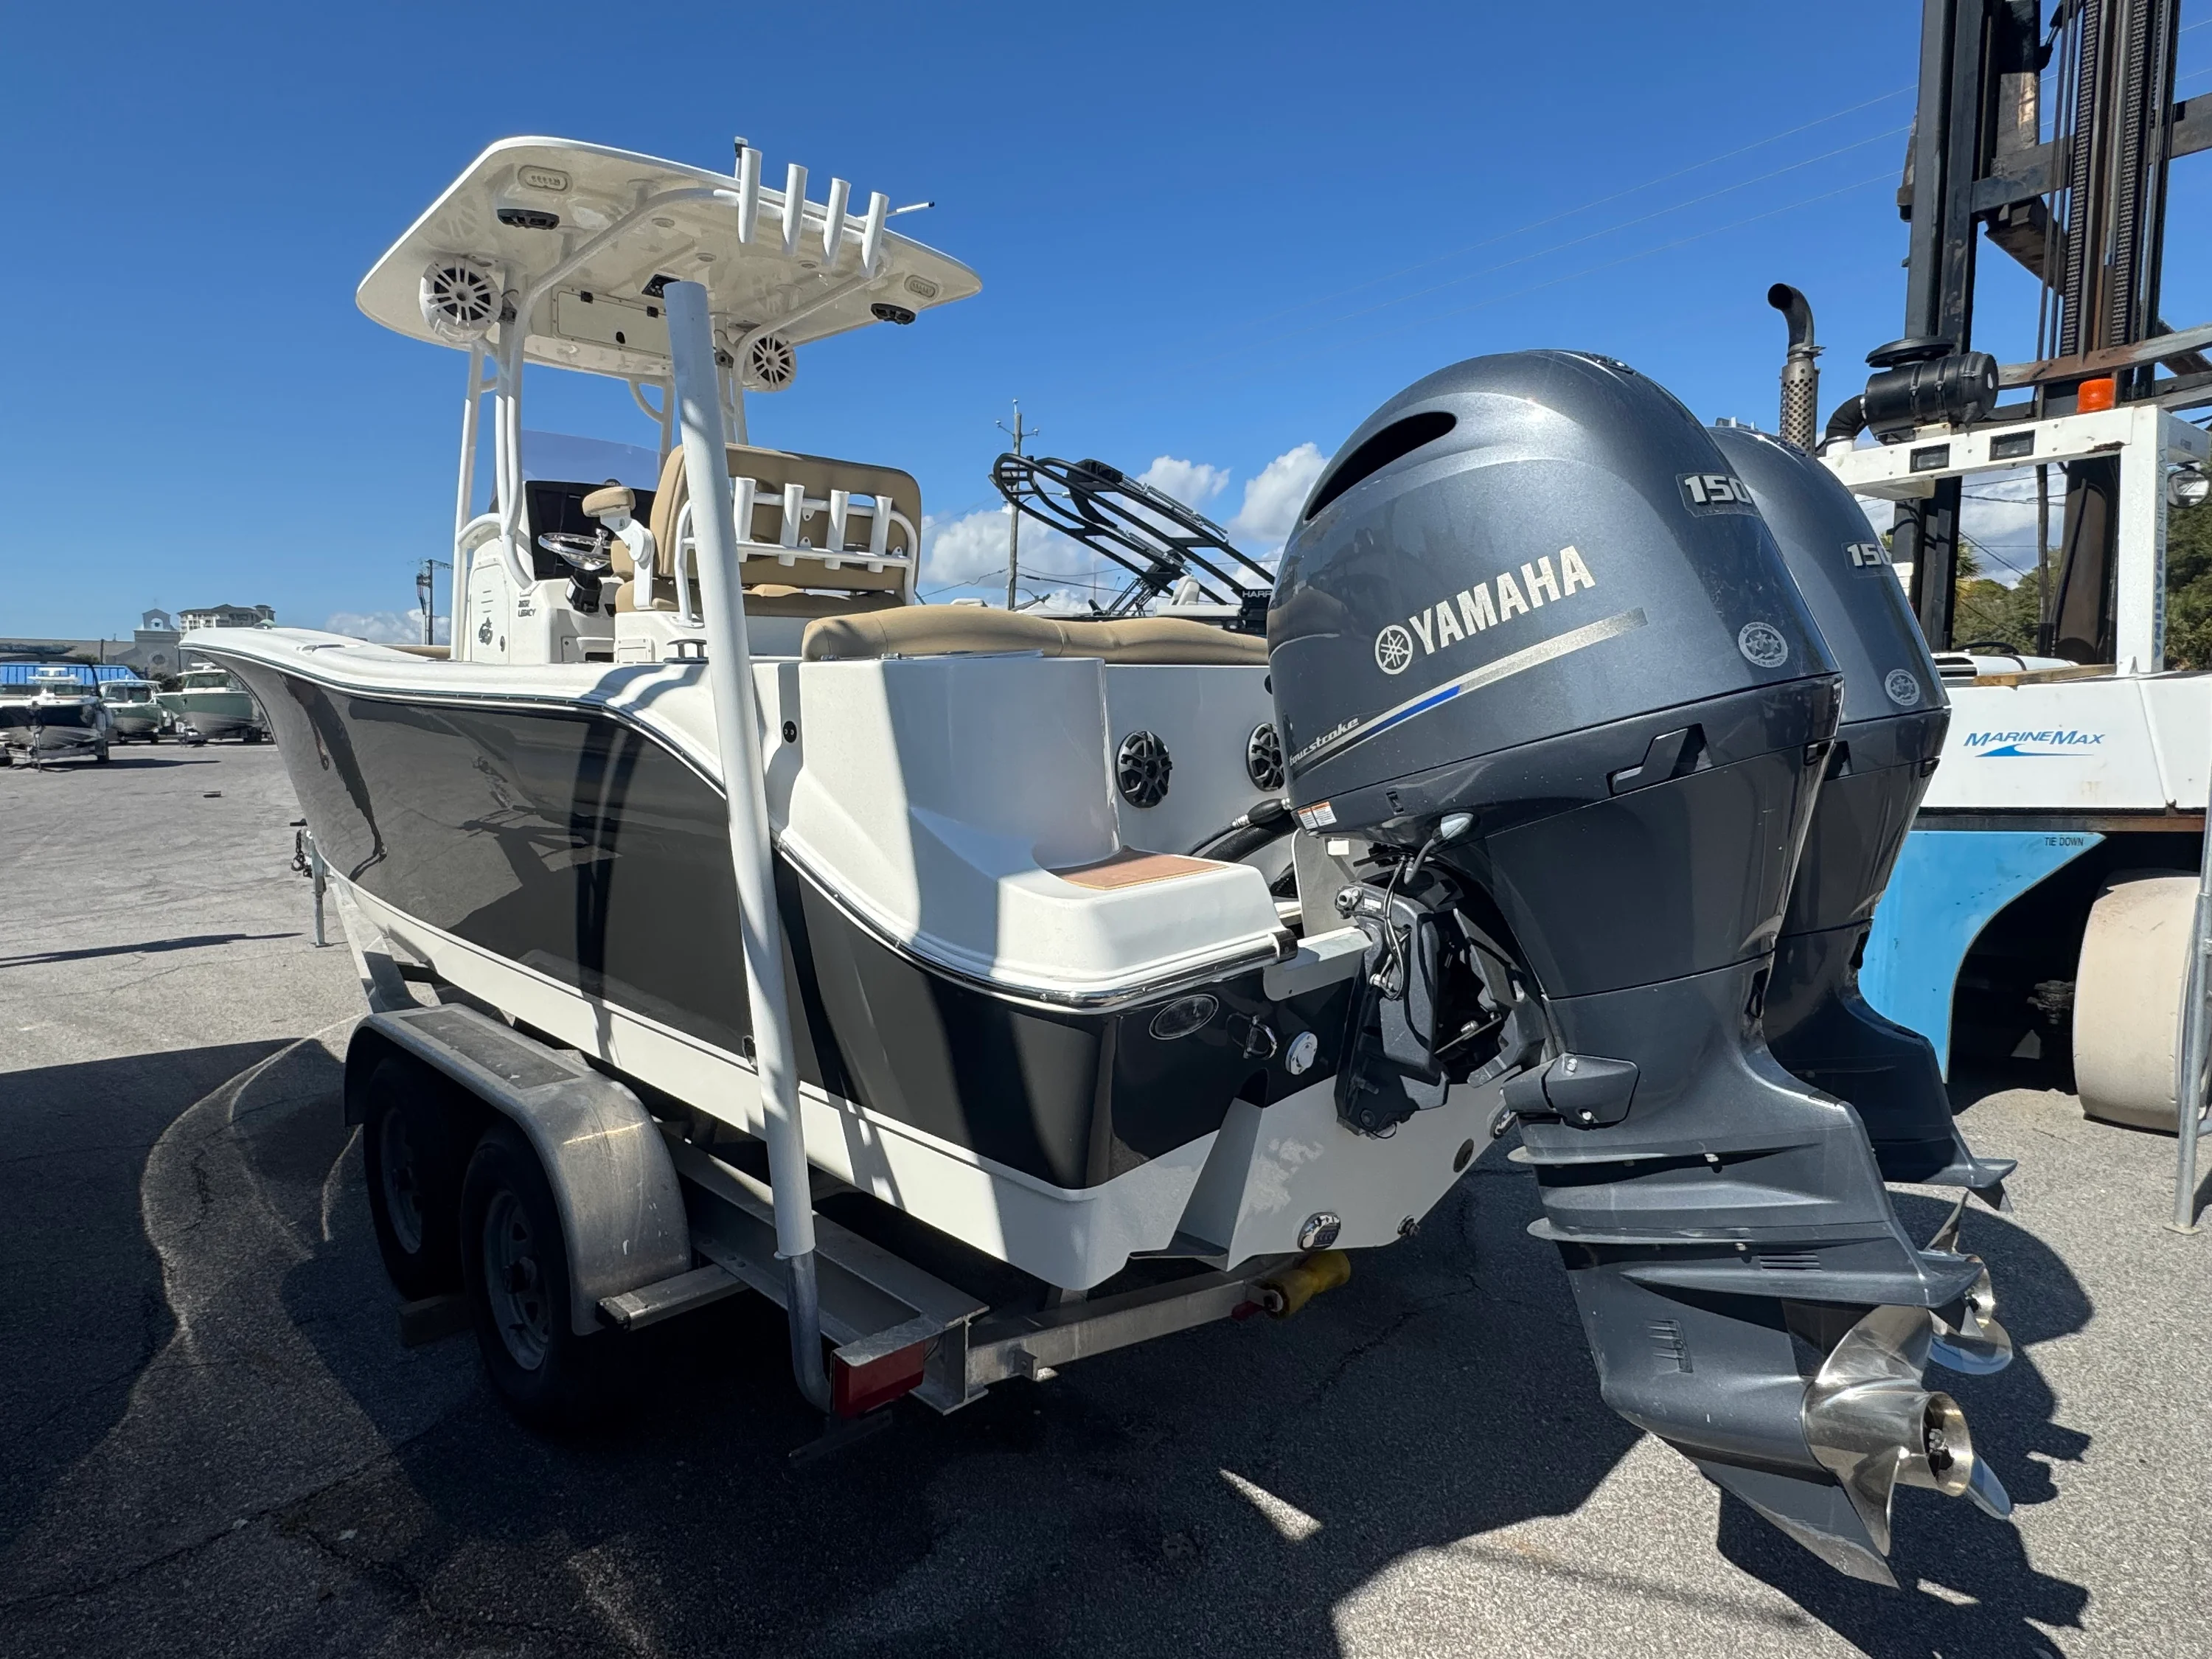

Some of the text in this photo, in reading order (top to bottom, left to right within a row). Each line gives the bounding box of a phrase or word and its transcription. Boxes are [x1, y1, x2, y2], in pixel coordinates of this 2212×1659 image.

[1685, 476, 1752, 504] 150
[1408, 546, 1596, 655] YAMAHA
[2045, 838, 2084, 846] TIE DOWN
